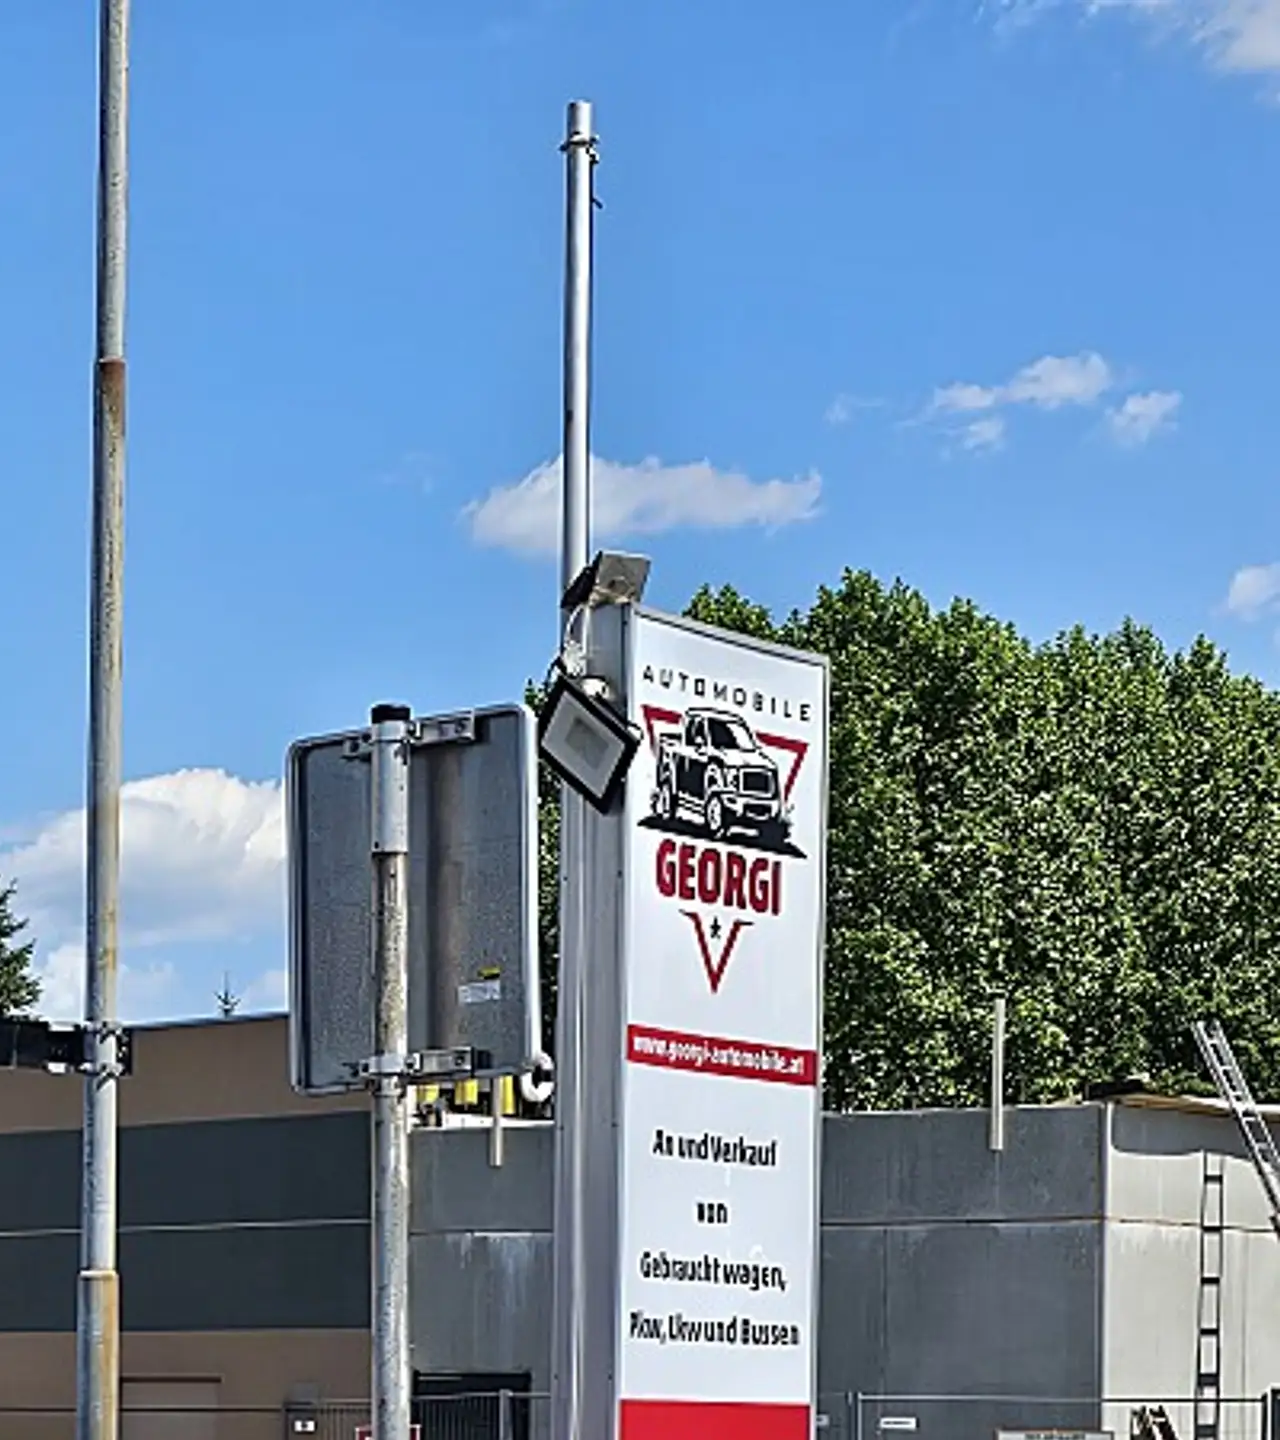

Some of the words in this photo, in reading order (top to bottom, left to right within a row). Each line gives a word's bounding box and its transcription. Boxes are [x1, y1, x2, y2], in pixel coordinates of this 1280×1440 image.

[643, 665, 811, 721] AUTOMOBILE
[656, 838, 782, 915] GEORGI
[633, 1034, 805, 1076] www.georgi-automobile.at
[653, 1130, 673, 1156] An
[678, 1133, 709, 1160] und
[711, 1136, 777, 1167] Verkauf
[705, 1316, 737, 1344] und
[741, 1318, 800, 1346] Bussen
